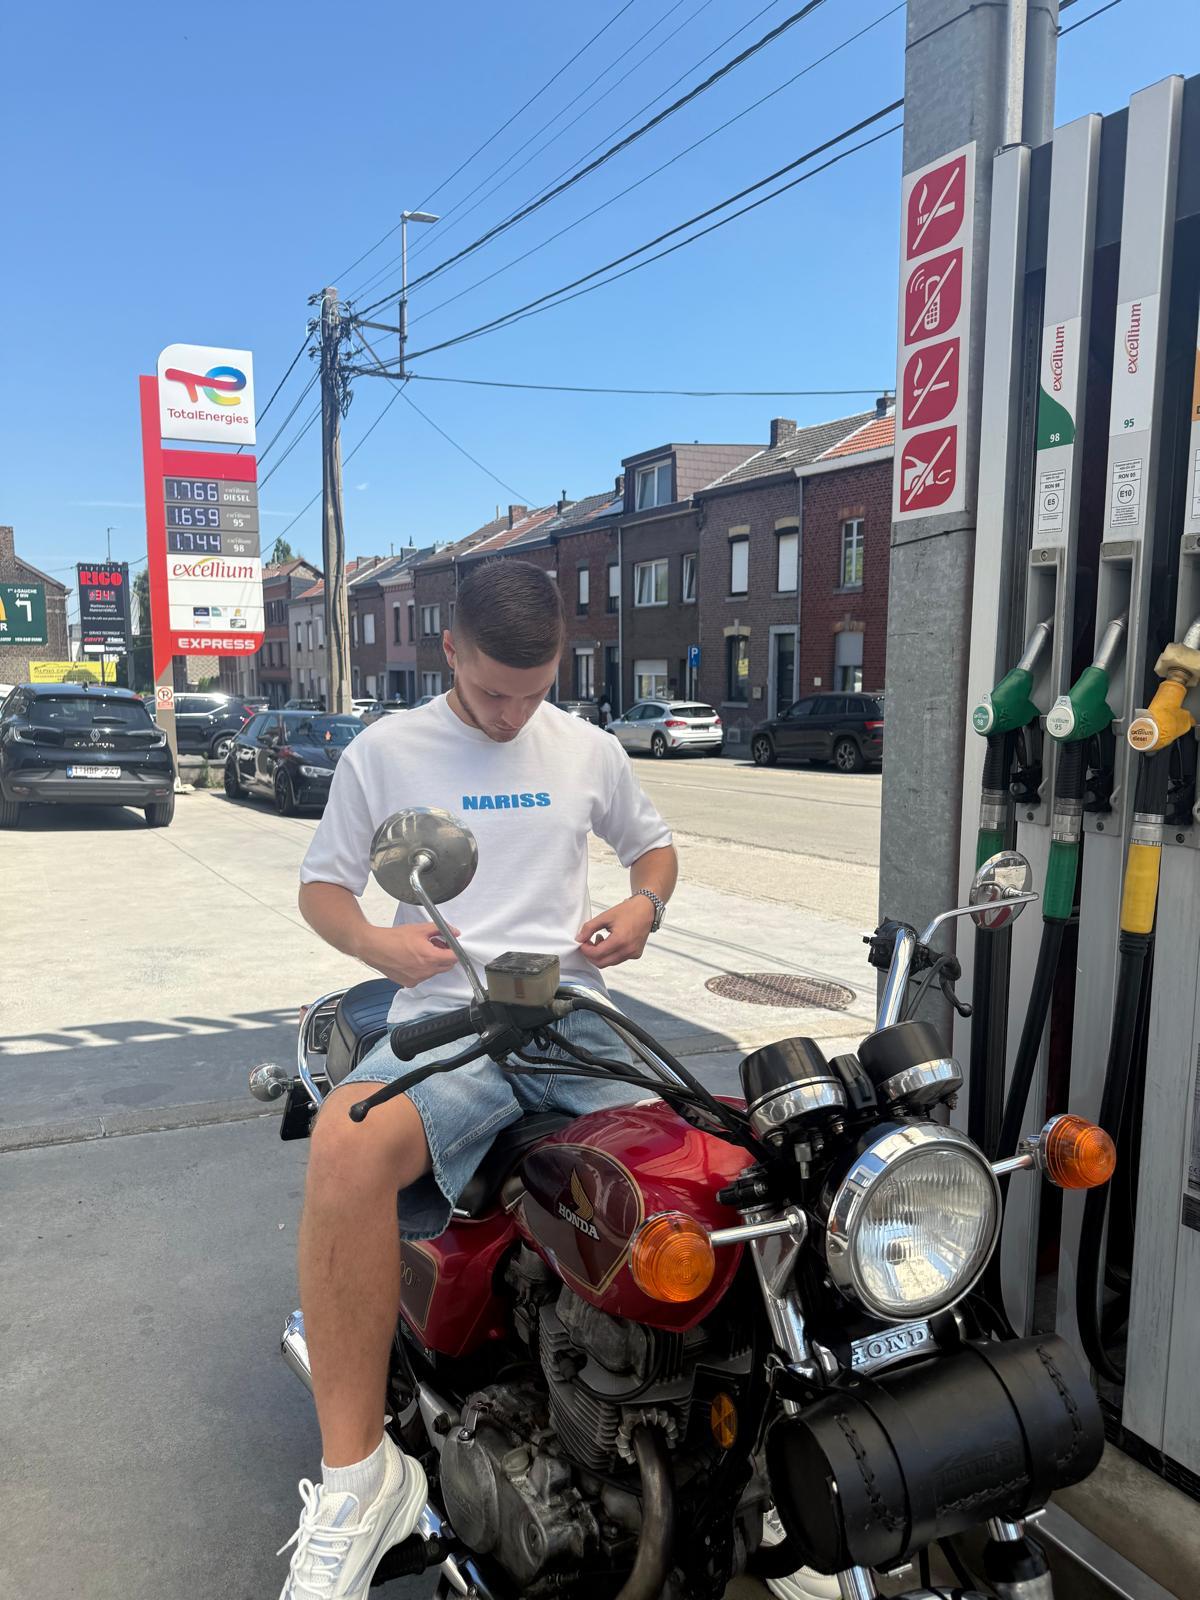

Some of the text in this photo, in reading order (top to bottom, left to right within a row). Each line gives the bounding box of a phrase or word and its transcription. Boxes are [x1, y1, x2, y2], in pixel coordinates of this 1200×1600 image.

[1127, 302, 1142, 374] excellium
[1052, 325, 1065, 392] excellium
[167, 407, 249, 425] TotalEnergies
[1123, 418, 1135, 429] 95
[1049, 432, 1060, 443] 98
[174, 481, 218, 501] 1.766
[223, 494, 251, 503] DIESEL
[1119, 489, 1132, 498] E10
[1047, 498, 1056, 506] E5
[175, 507, 219, 527] 1.659
[233, 518, 244, 528] 95
[176, 533, 221, 551] 1.744
[233, 544, 245, 553] 98
[172, 559, 253, 579] excellium
[178, 637, 256, 650] EXPRESS
[691, 647, 698, 658] P
[1054, 723, 1063, 731] 95
[462, 791, 551, 810] NARISS
[558, 1202, 600, 1240] HONDA
[852, 1327, 932, 1366] HOND
